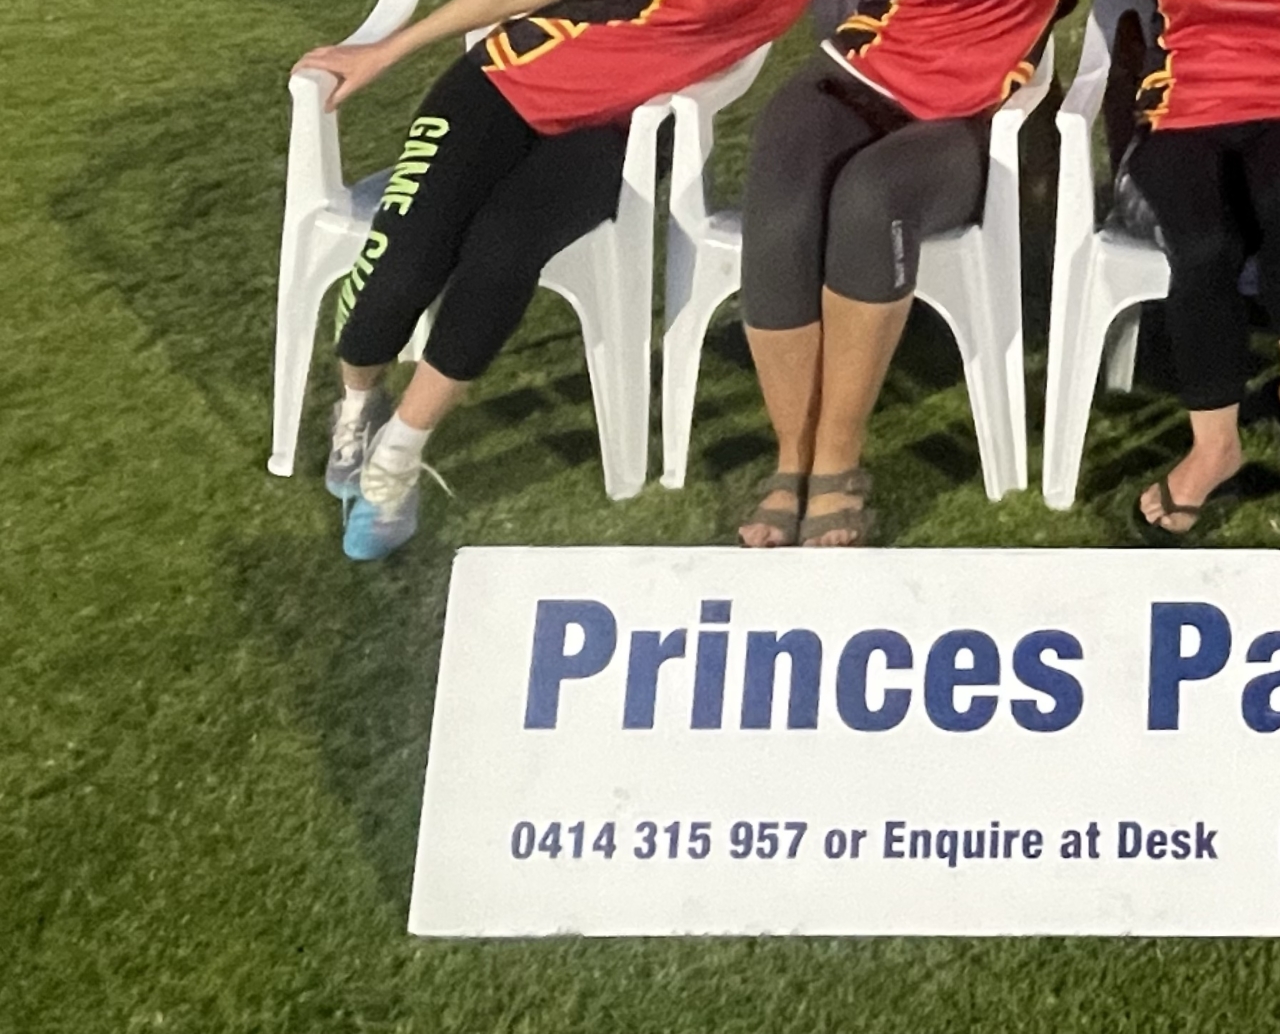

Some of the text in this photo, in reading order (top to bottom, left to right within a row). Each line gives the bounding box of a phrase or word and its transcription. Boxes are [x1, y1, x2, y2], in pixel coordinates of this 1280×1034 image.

[380, 116, 451, 216] GAME
[525, 599, 1084, 734] Princes
[511, 821, 617, 860] 0414
[634, 821, 711, 860] 315
[730, 821, 808, 860] 957
[824, 828, 868, 860] or
[883, 820, 1044, 869] Enquire
[1060, 821, 1101, 860] at
[1117, 820, 1218, 860] Desk
